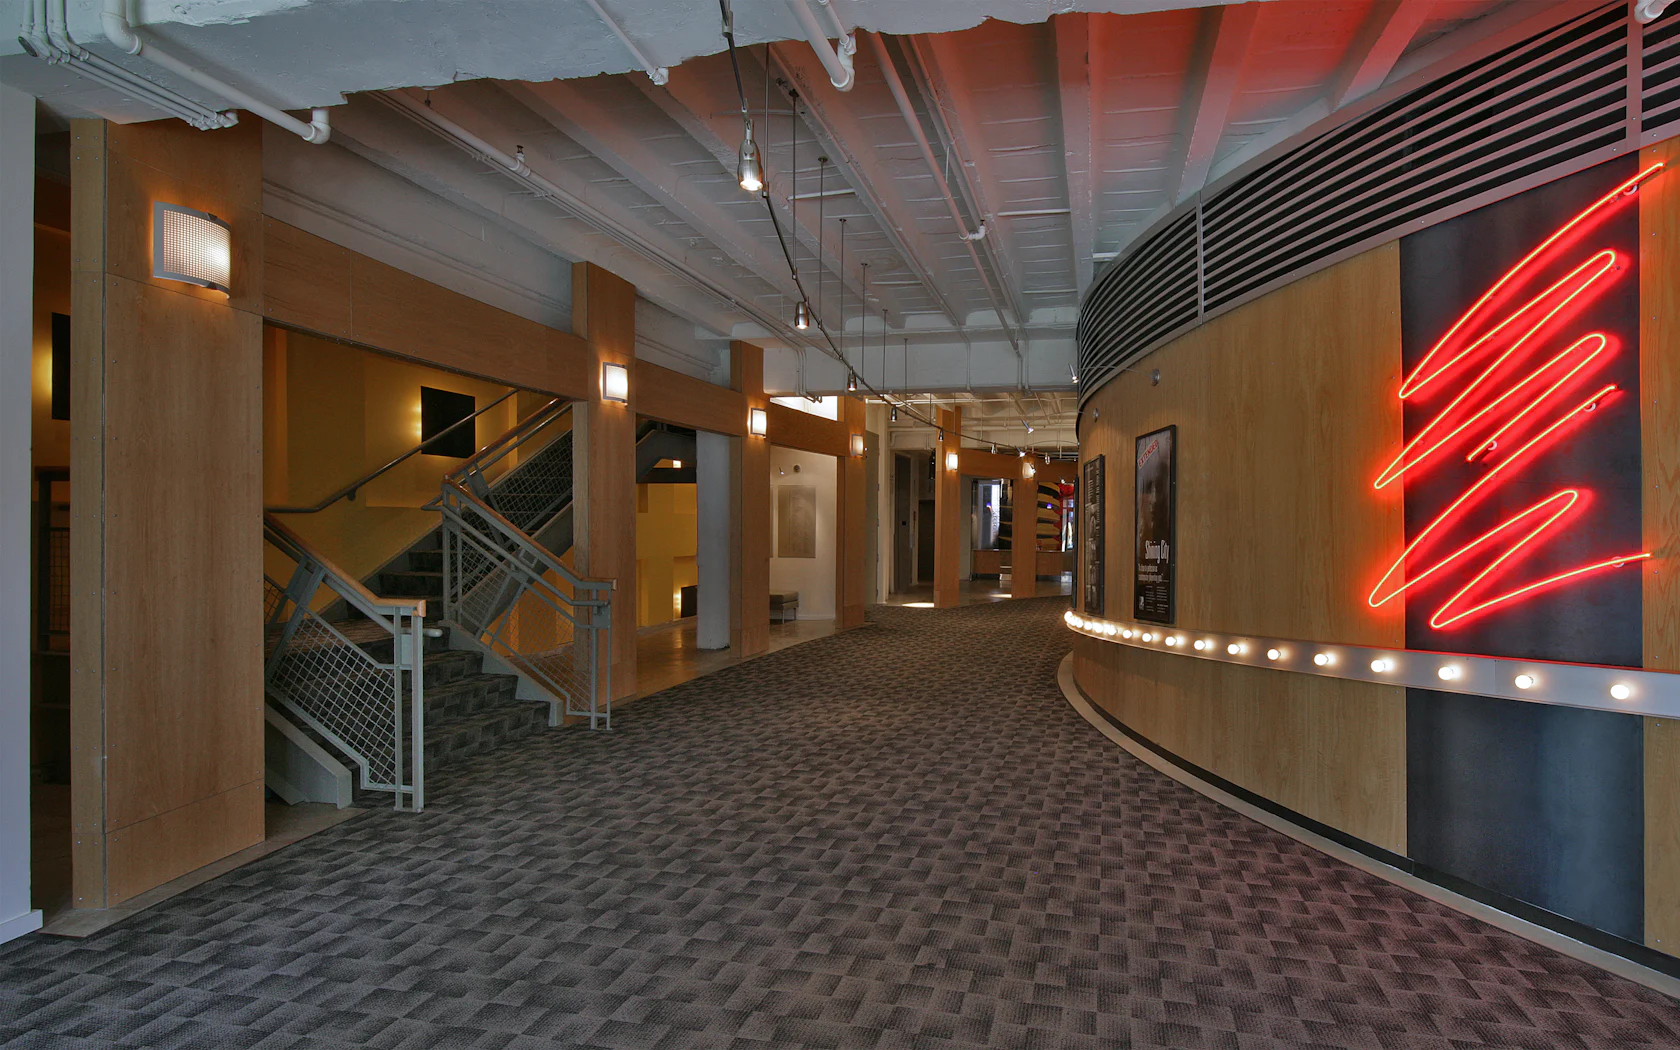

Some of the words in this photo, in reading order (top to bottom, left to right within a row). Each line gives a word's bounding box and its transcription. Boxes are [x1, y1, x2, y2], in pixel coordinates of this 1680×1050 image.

[1138, 439, 1159, 468] EXTENDED
[1145, 540, 1160, 563] Shining
[1160, 539, 1170, 563] City
